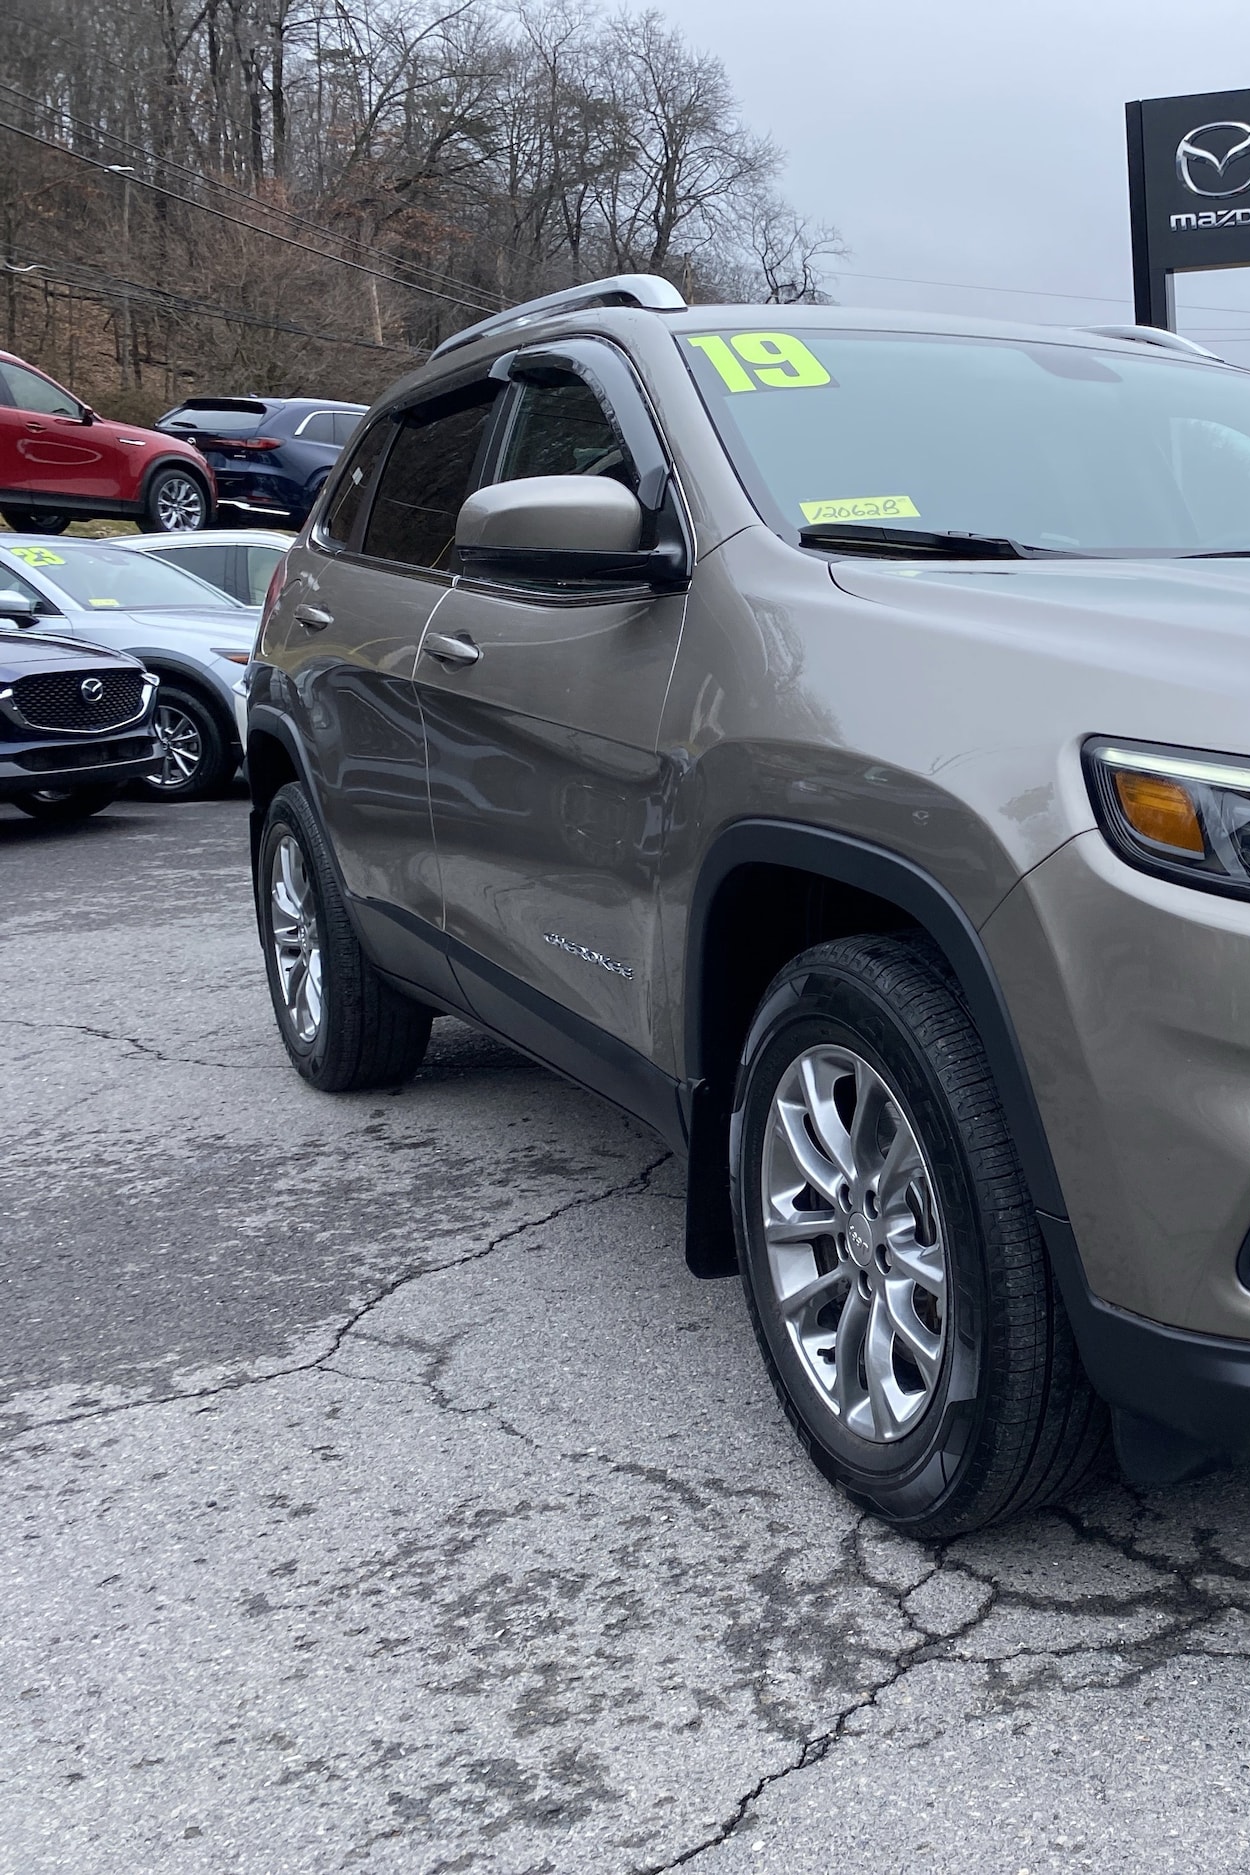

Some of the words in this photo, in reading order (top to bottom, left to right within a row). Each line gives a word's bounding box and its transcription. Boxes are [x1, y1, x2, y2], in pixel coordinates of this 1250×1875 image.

[687, 332, 831, 393] 19
[812, 499, 900, 521] 12062B
[10, 547, 66, 567] 23
